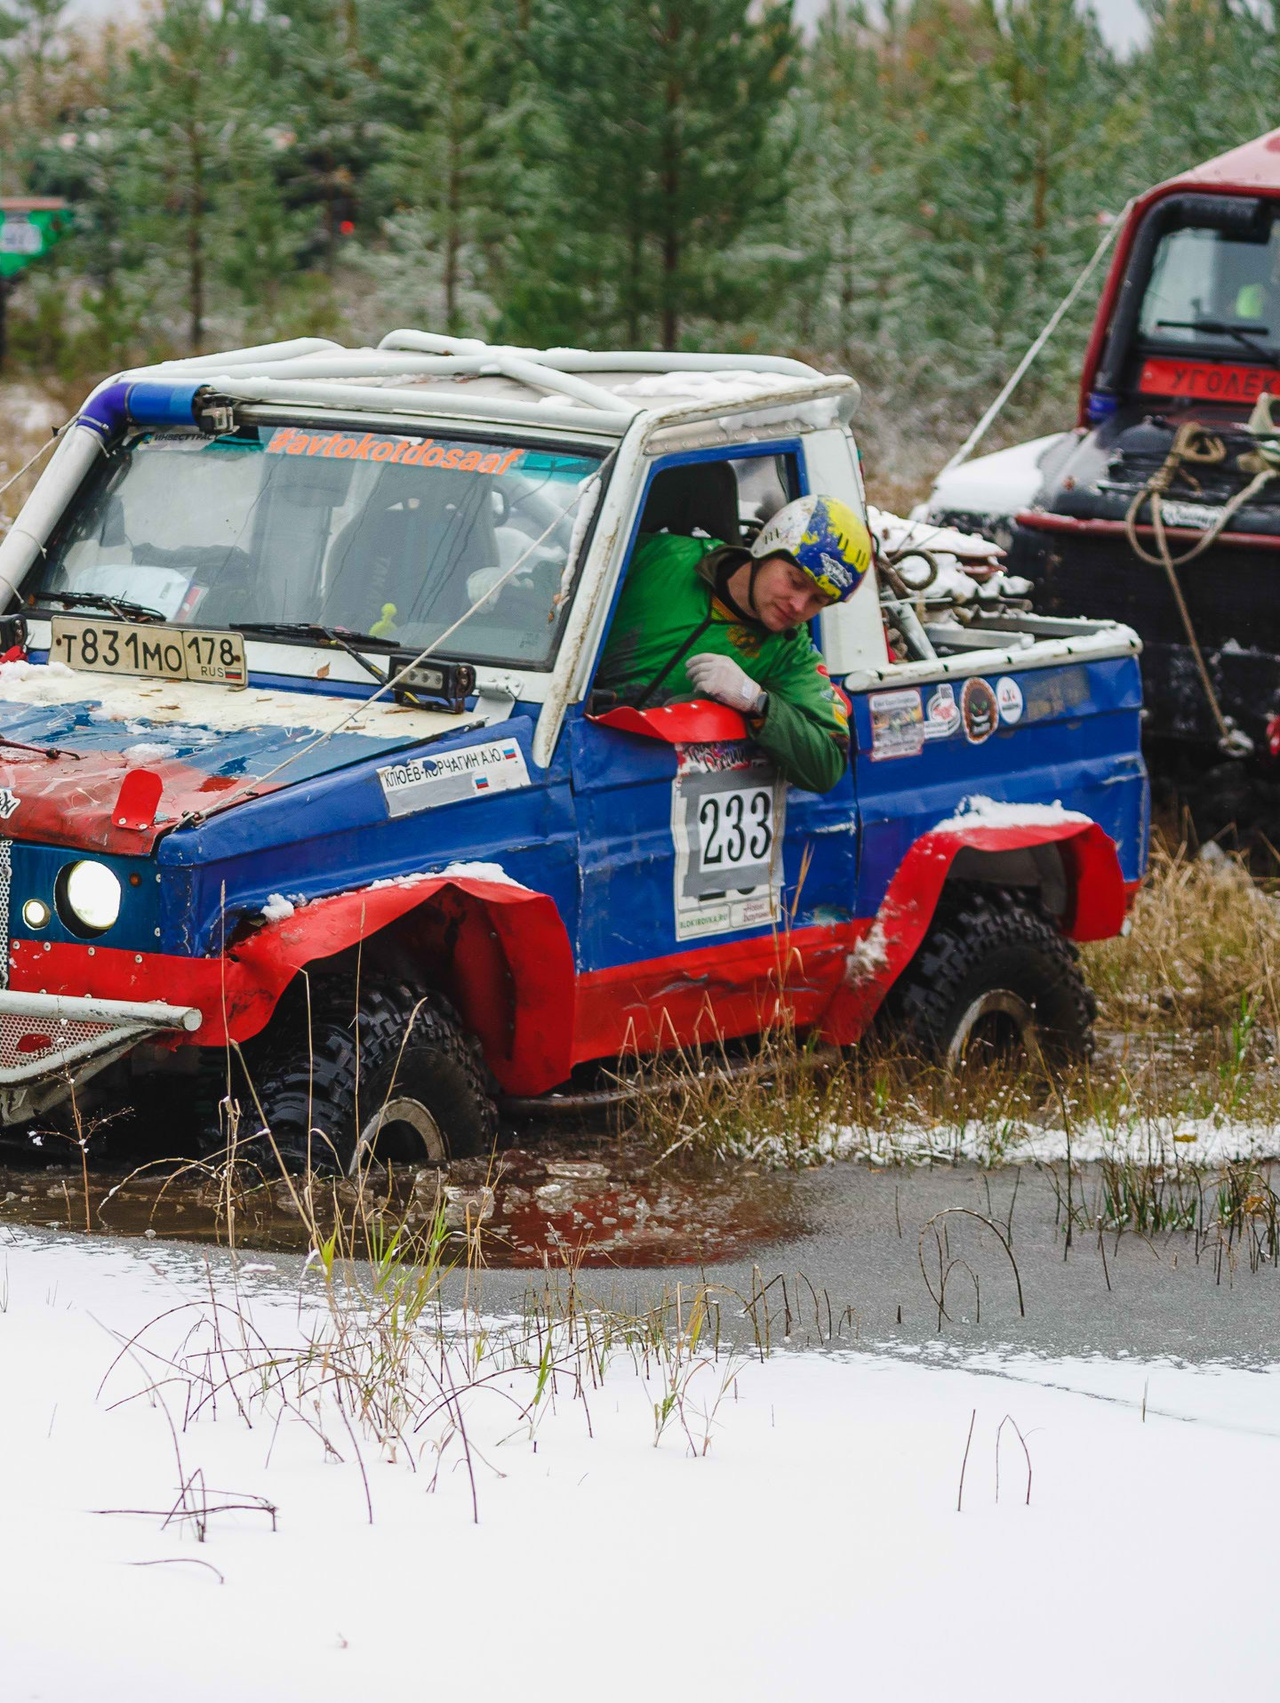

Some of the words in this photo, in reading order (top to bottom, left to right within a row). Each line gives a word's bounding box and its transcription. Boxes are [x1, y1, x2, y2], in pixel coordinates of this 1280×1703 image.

[268, 428, 524, 475] #avtokotdosaaf
[62, 628, 182, 672] Т831МО
[188, 637, 234, 666] 178
[201, 667, 224, 678] RUS
[700, 791, 772, 865] 233
